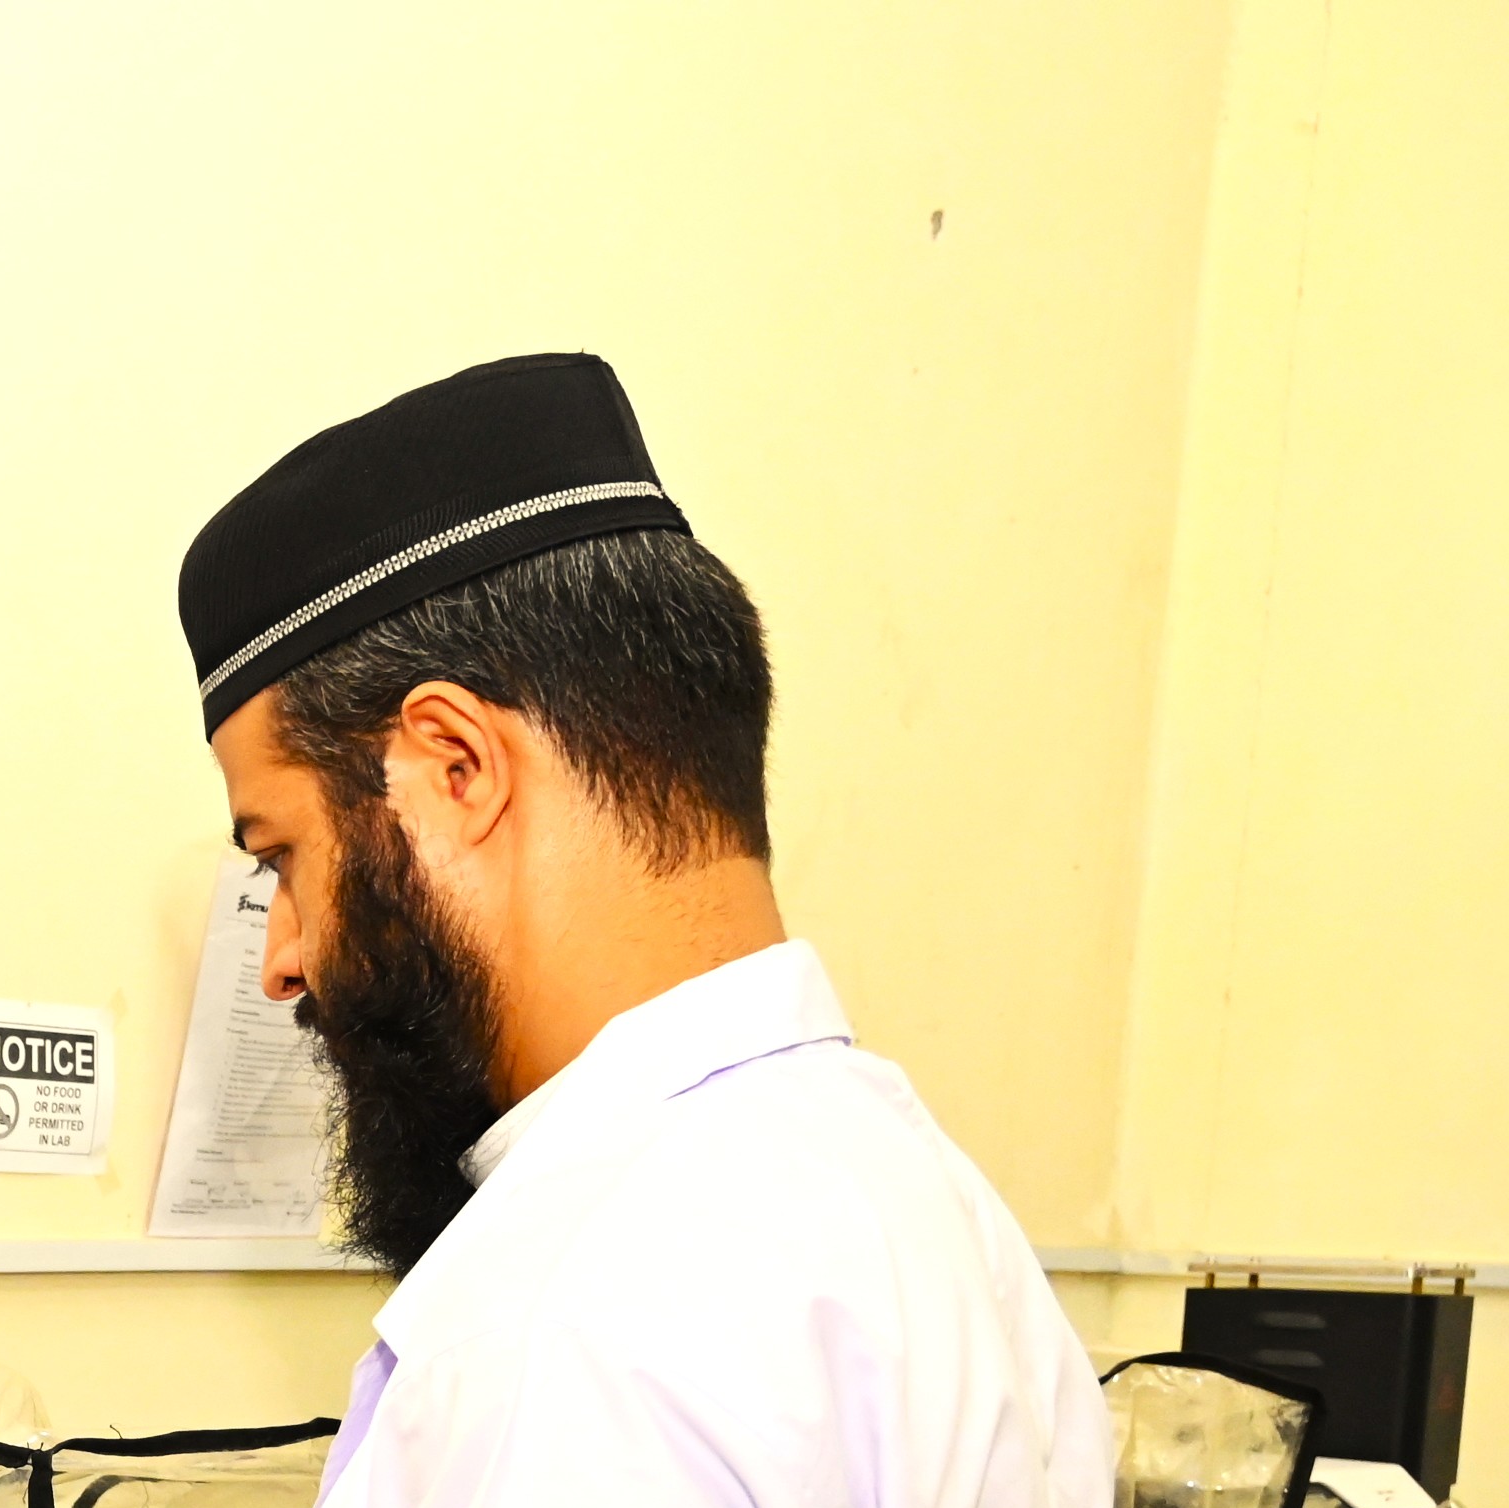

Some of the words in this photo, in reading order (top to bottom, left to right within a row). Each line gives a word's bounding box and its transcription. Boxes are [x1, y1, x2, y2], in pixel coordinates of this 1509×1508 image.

[37, 1086, 50, 1096] NO
[54, 1087, 81, 1098] FOOD
[34, 1101, 48, 1112] OR
[52, 1102, 81, 1114] DRINK
[29, 1118, 83, 1131] PERMITTED
[39, 1134, 48, 1145] IN
[51, 1135, 70, 1147] LAB
